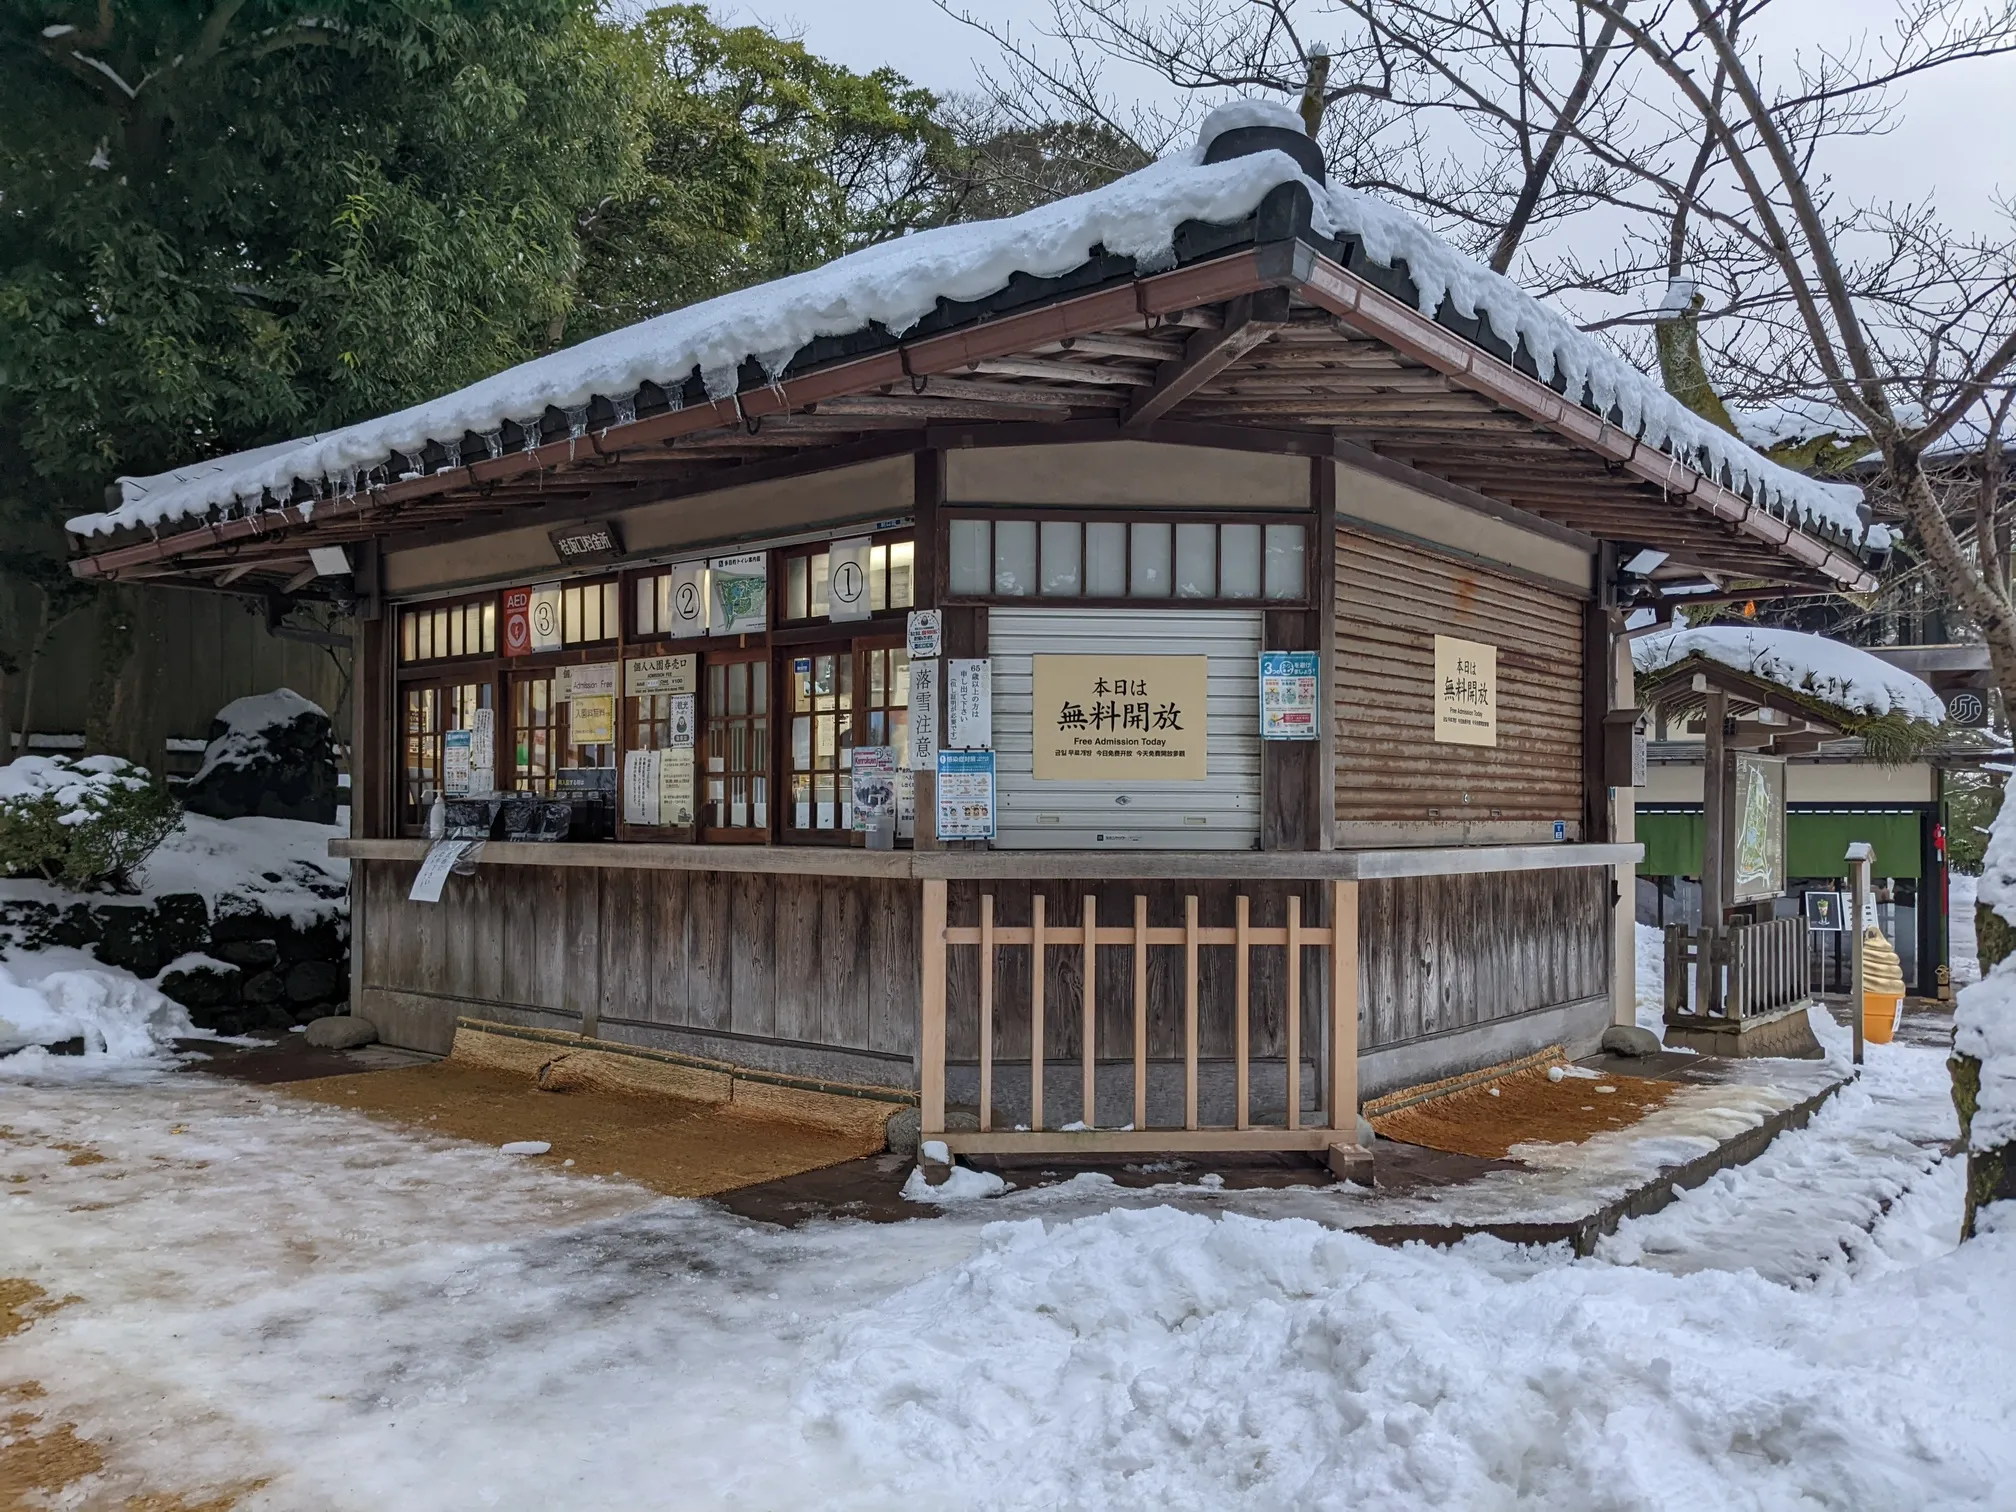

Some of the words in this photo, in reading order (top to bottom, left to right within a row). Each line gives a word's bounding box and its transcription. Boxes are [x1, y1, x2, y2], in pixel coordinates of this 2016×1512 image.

[558, 532, 612, 555] 桂坂口料金所
[507, 594, 527, 608] AED
[633, 658, 687, 672] 個人入園券売口
[1456, 657, 1477, 676] 本日は
[573, 681, 598, 690] Admission
[600, 679, 613, 688] Free
[970, 664, 981, 718] 65歳以上の方は
[1092, 676, 1148, 698] 本日は
[1443, 676, 1489, 706] 無料開放
[960, 670, 968, 723] 申し出て下さい
[915, 668, 932, 758] 落雪注意
[1057, 700, 1184, 733] 無料開放
[1449, 706, 1457, 714] Free
[1473, 709, 1483, 718] Today
[1073, 737, 1092, 745] Free
[1094, 737, 1139, 745] Admission
[1141, 737, 1166, 747] Today
